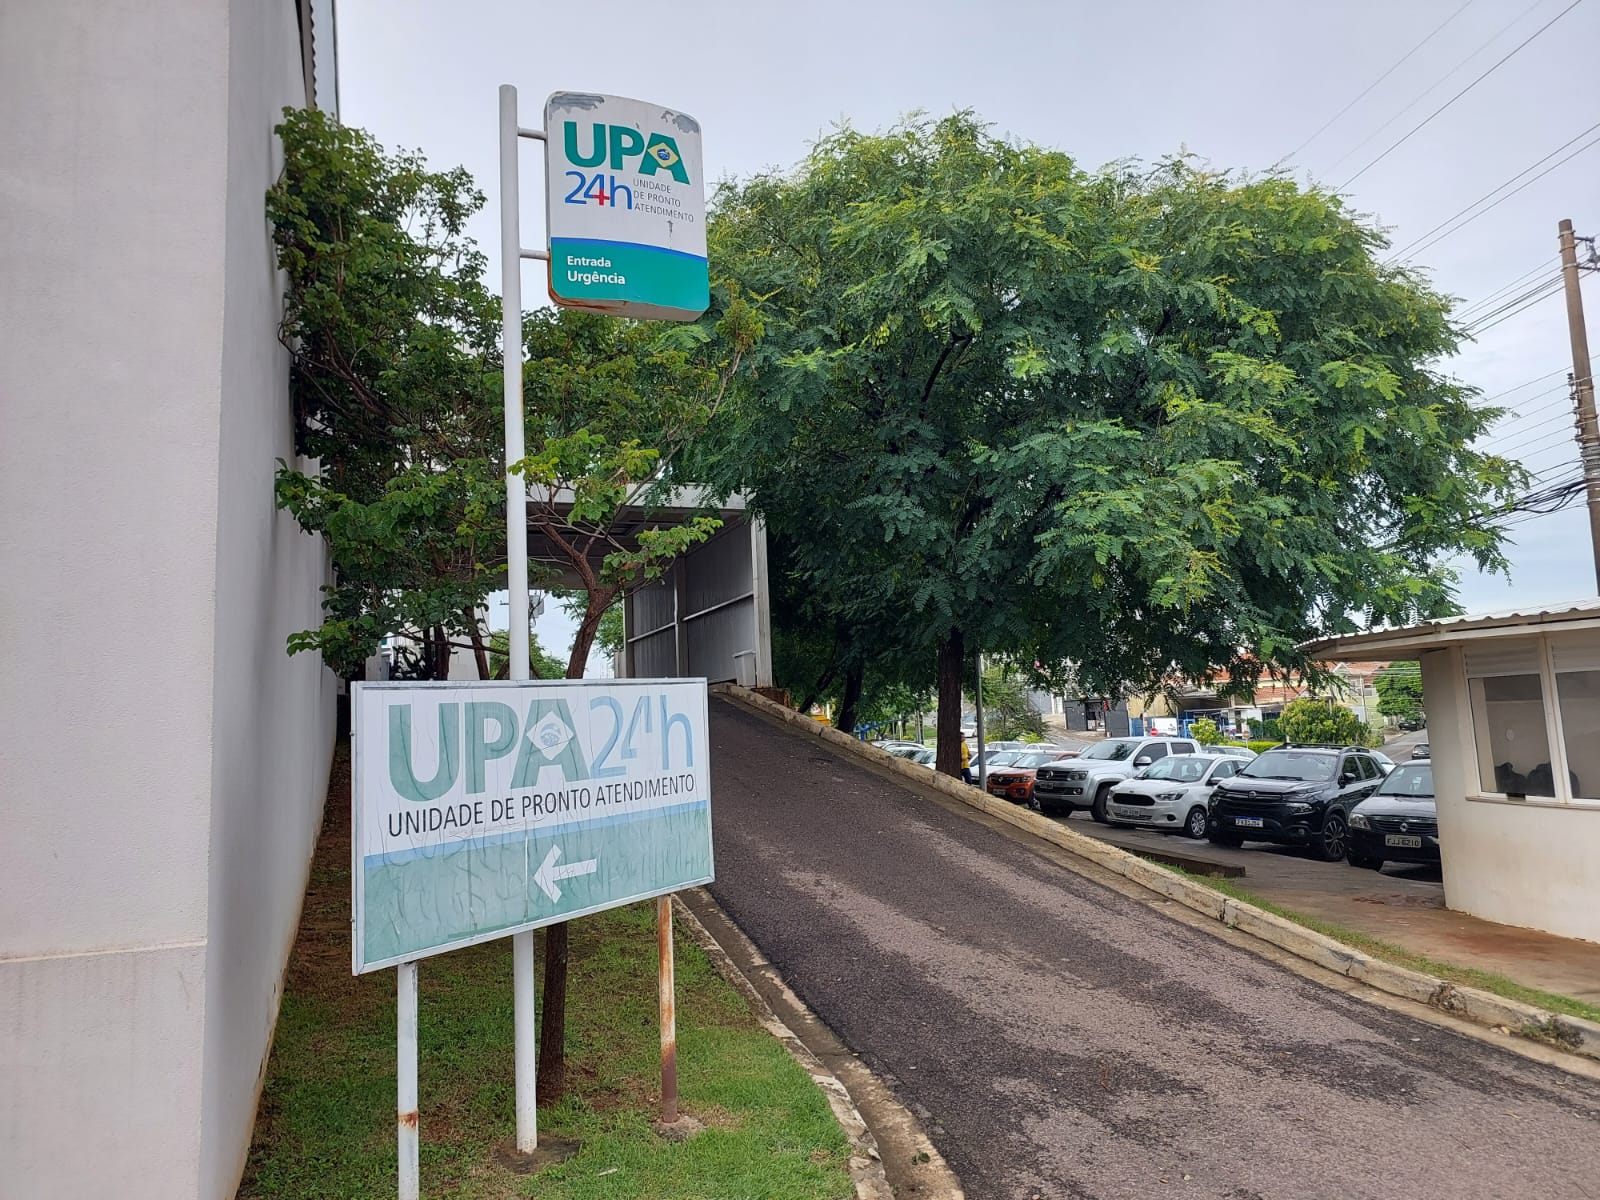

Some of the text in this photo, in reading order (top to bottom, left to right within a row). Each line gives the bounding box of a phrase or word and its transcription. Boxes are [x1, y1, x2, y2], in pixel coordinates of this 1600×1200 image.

[563, 121, 691, 185] UPA
[564, 171, 632, 210] 24h
[633, 178, 671, 193] UNIDADE
[633, 190, 681, 207] DE PRONTO
[634, 203, 694, 222] ATENDIMENTO
[567, 255, 612, 268] Entrada
[567, 270, 626, 285] Urgência
[388, 694, 694, 802] UPA 24h
[388, 773, 695, 837] UNIDADE DE PRONTO ATENDIMENTO
